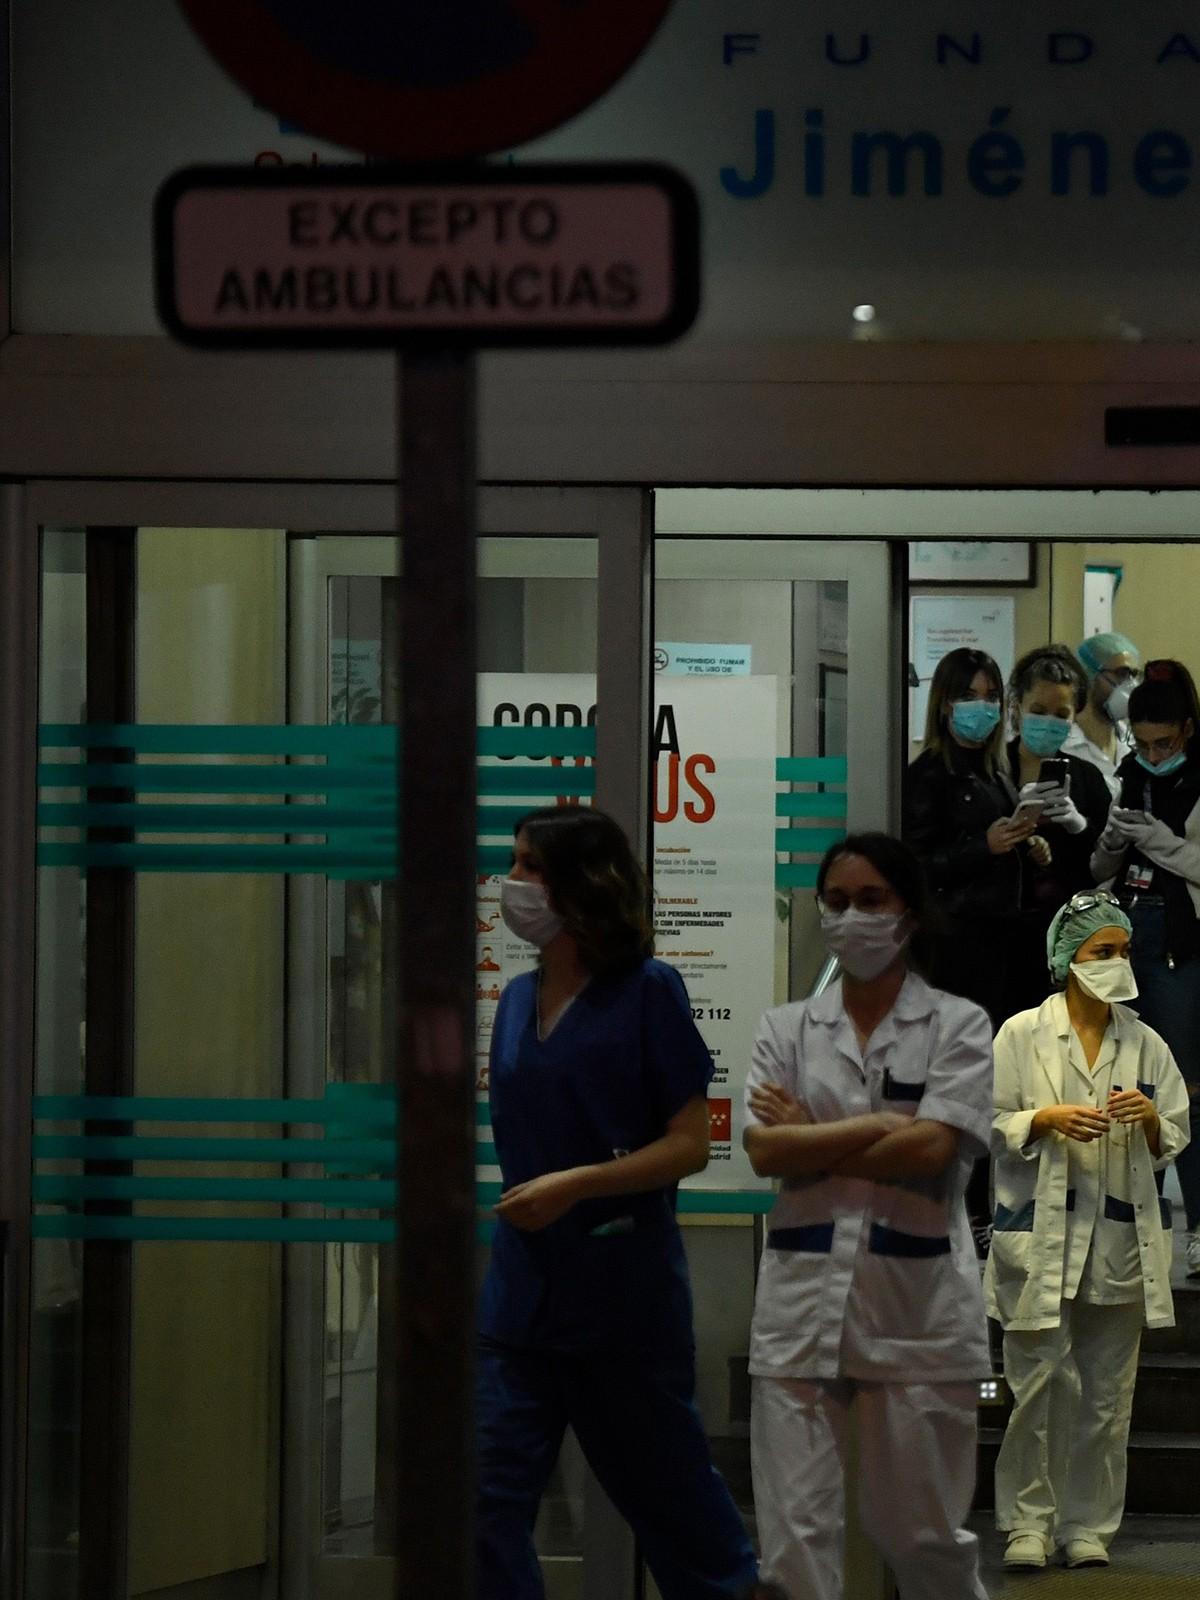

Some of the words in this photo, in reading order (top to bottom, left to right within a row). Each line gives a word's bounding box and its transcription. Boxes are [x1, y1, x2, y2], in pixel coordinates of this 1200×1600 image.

[289, 201, 560, 246] EXCEPTO
[215, 262, 640, 312] AMBULANCIAS
[708, 1008, 731, 1020] 112
